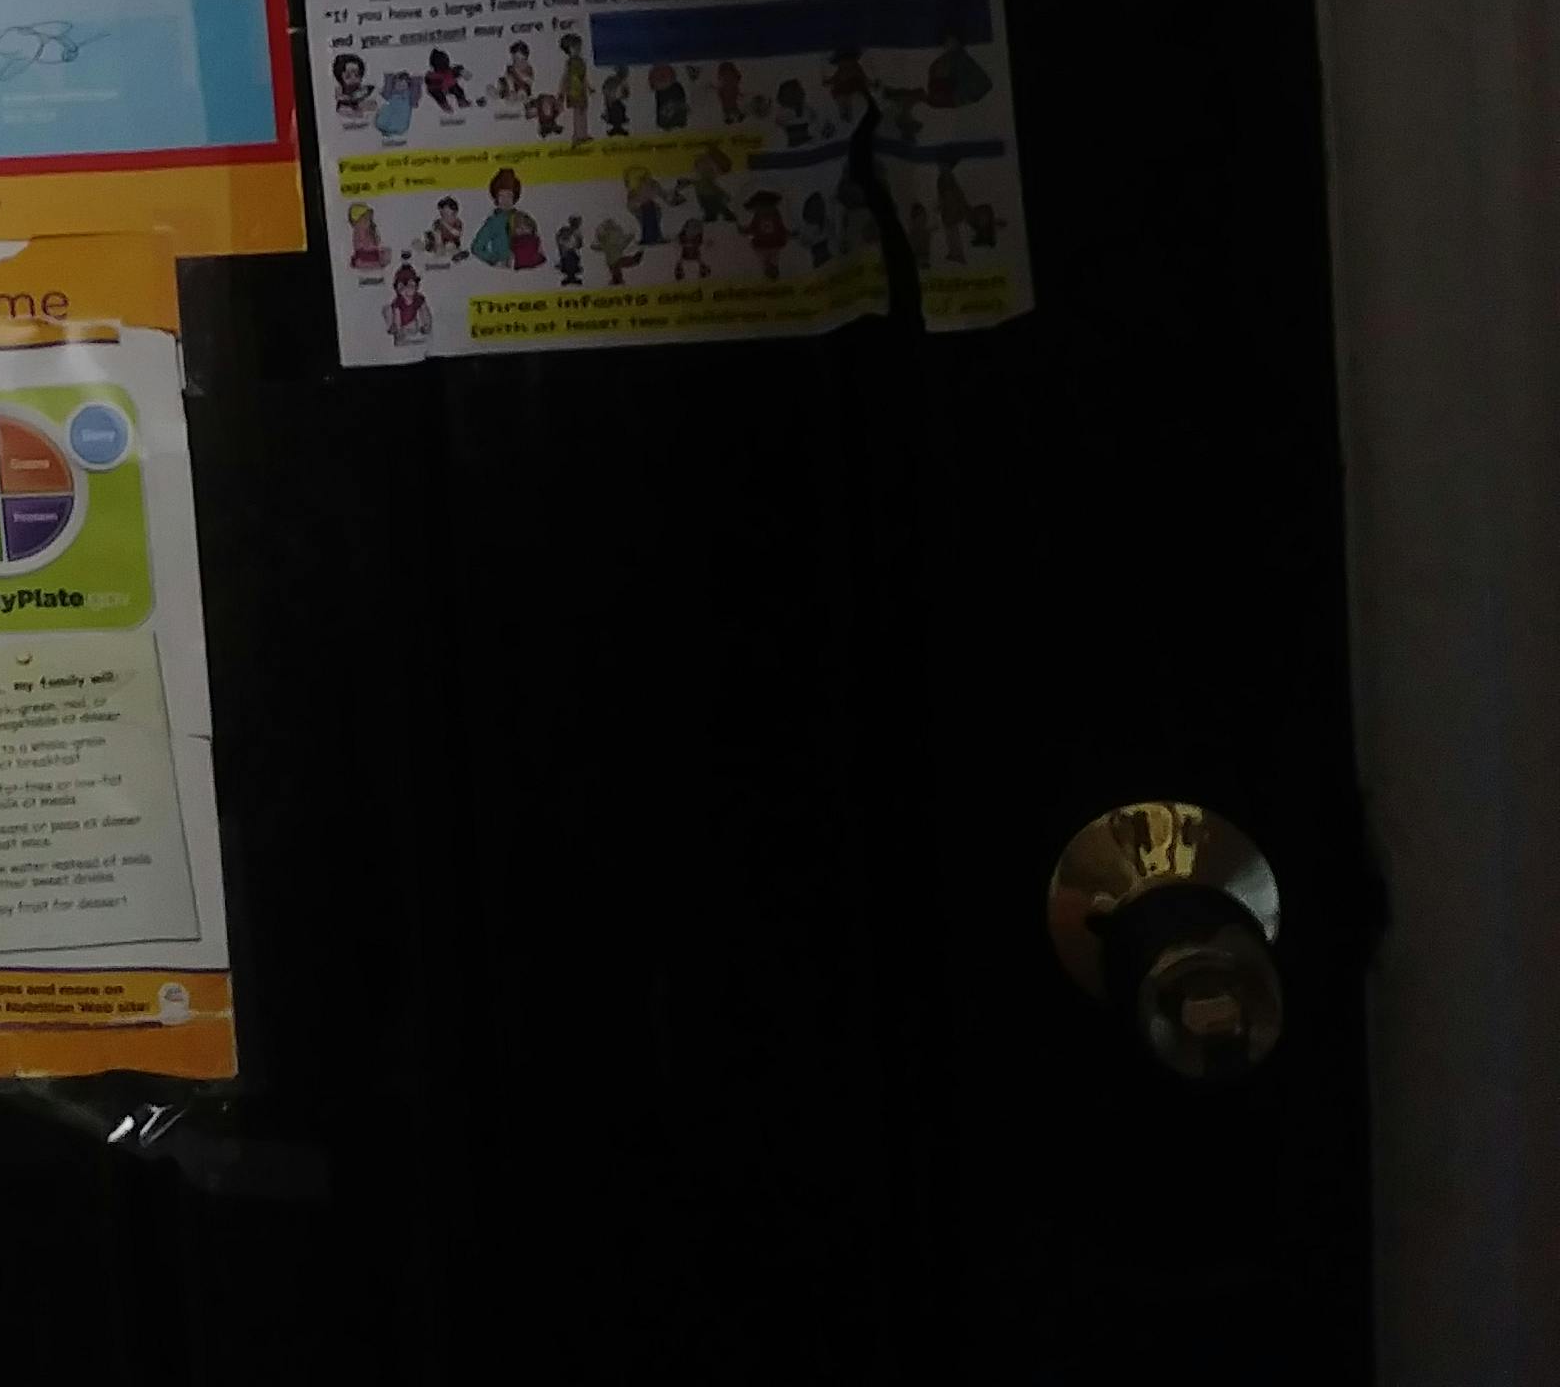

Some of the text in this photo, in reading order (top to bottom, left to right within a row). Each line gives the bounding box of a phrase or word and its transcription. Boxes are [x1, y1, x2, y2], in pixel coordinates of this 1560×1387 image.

[40, 675, 84, 689] family
[26, 982, 56, 995] and
[58, 984, 101, 996] more
[103, 984, 124, 995] on
[5, 1000, 75, 1013] Nutrition
[78, 1000, 115, 1012] Web
